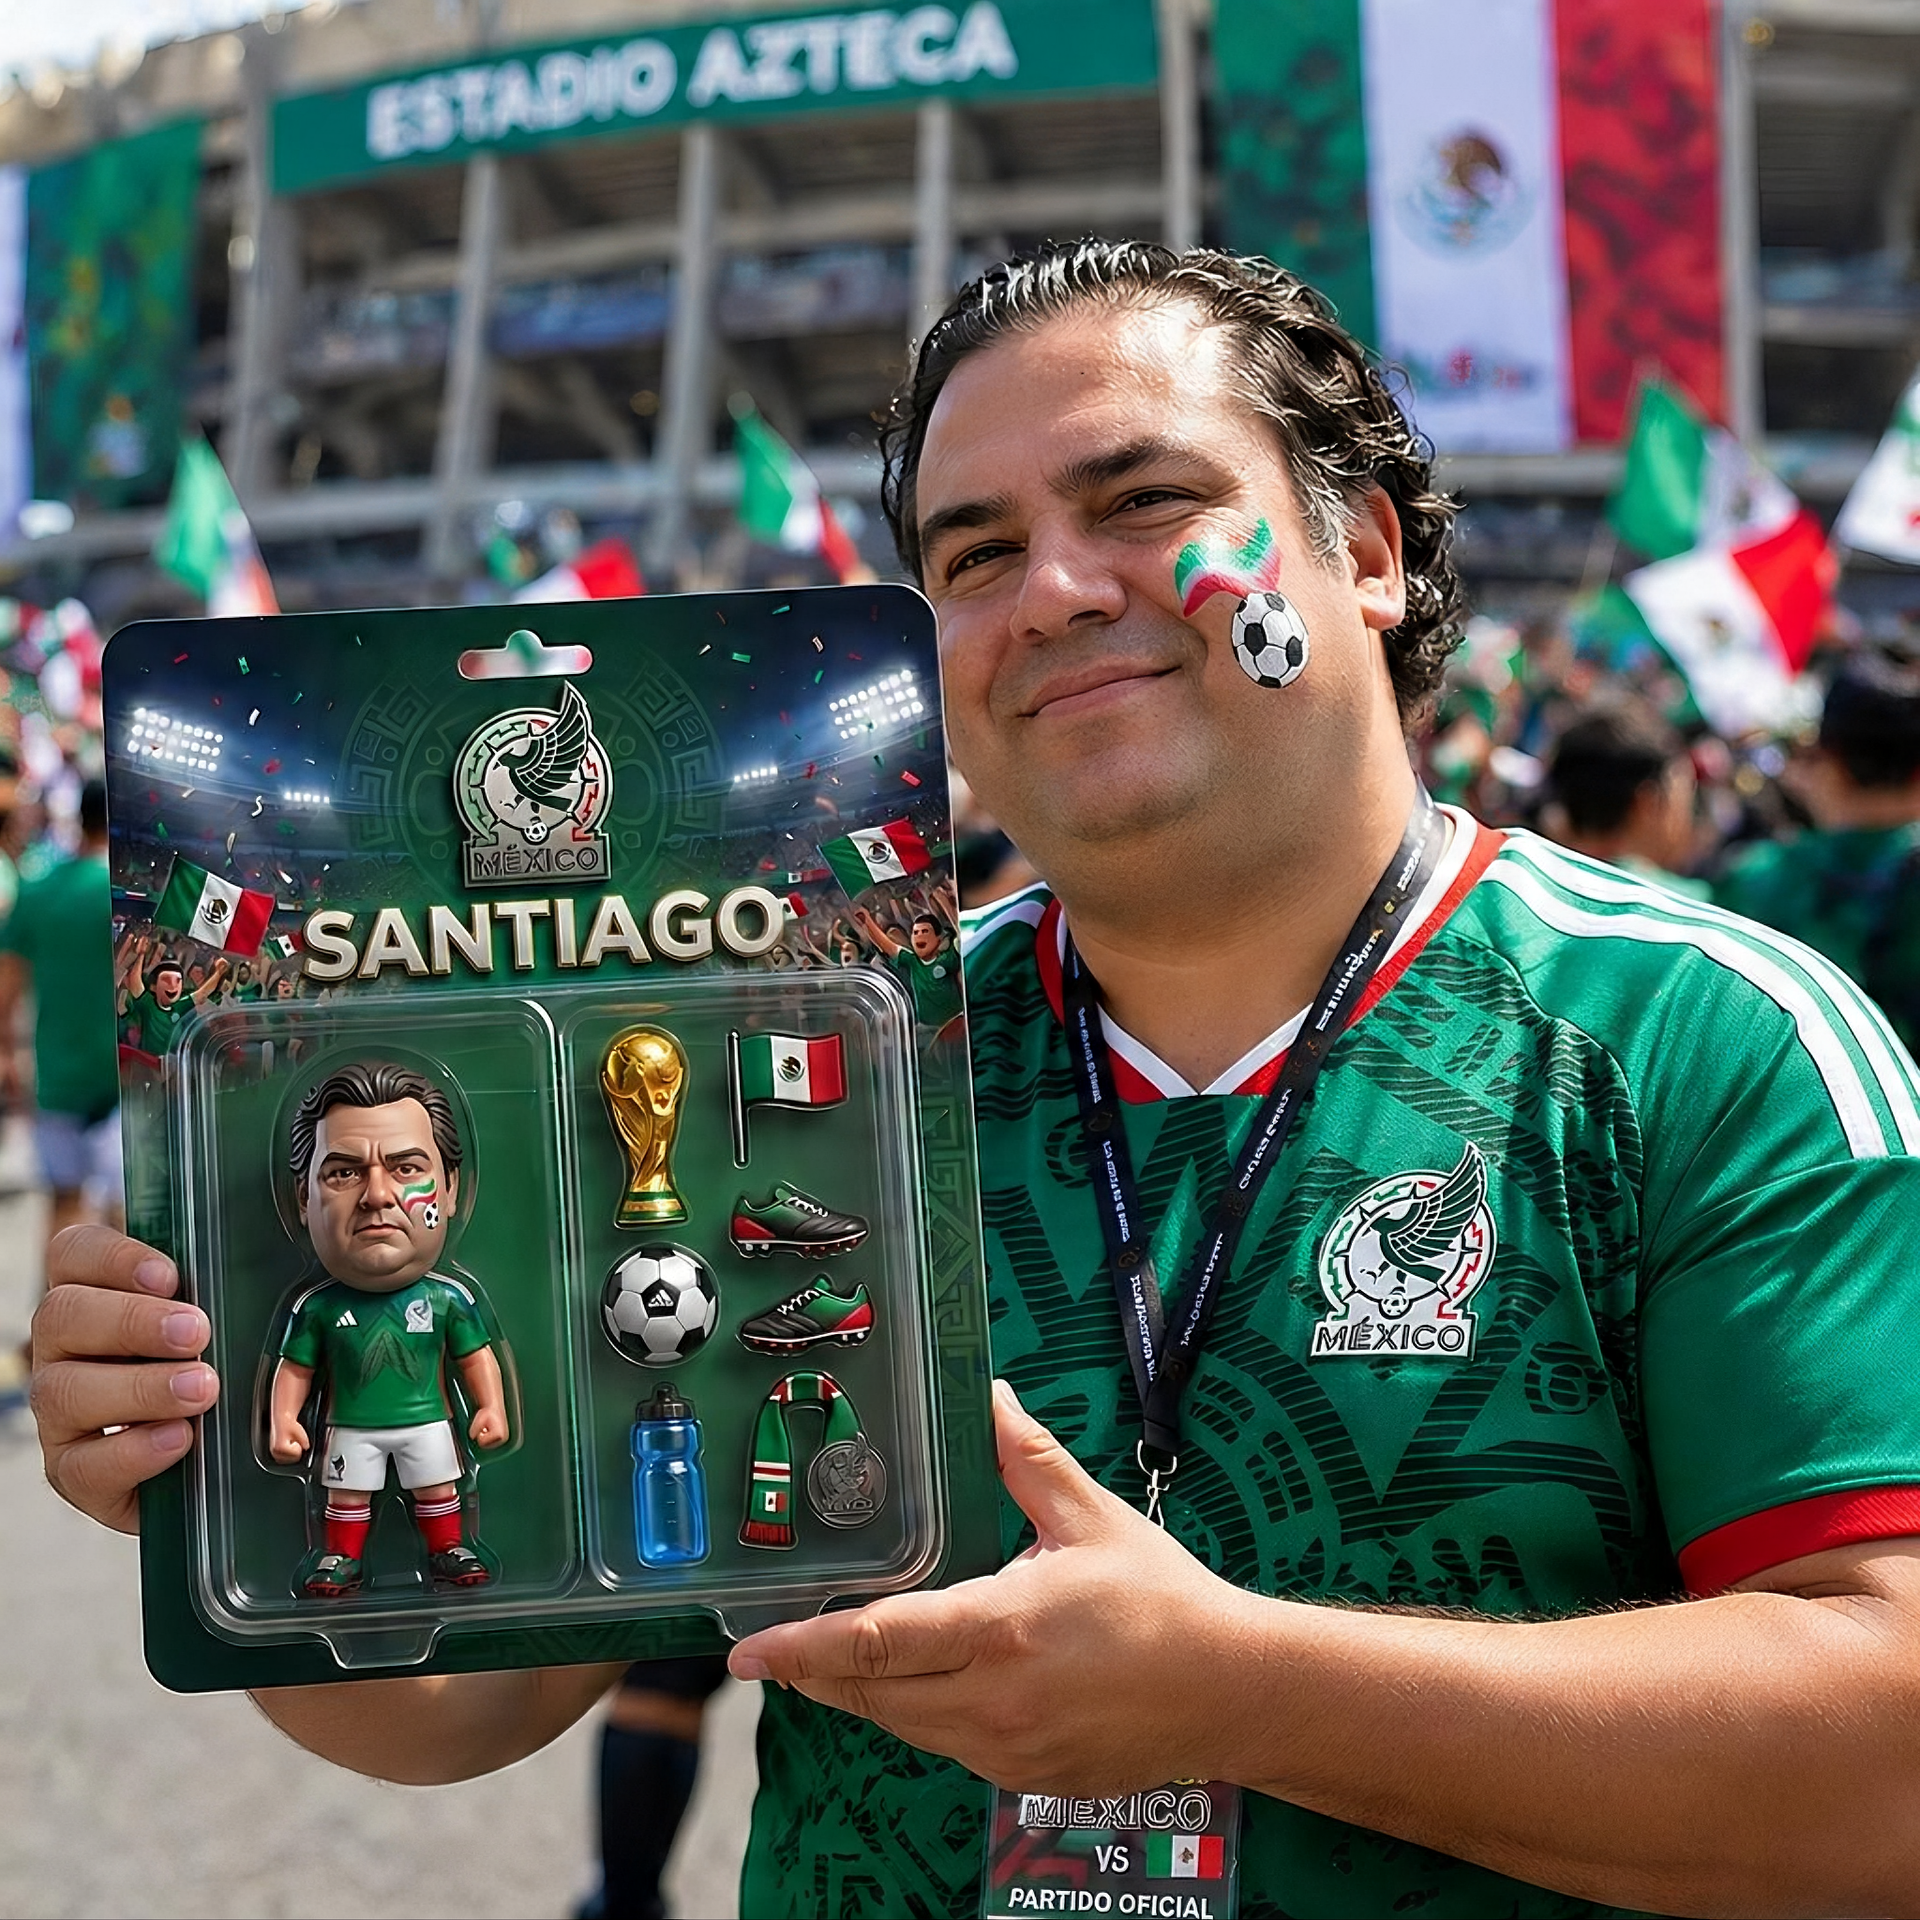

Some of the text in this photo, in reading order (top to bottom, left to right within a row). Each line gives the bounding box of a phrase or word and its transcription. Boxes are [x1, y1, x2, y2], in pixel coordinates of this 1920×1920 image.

[366, 0, 1018, 160] ESTADIO AZTECA
[302, 886, 786, 982] SANTIAGO
[1316, 1316, 1465, 1352] MÉXICO
[1094, 1845, 1130, 1873] VS
[1008, 1888, 1214, 1919] PARTIDO OFICIAL
